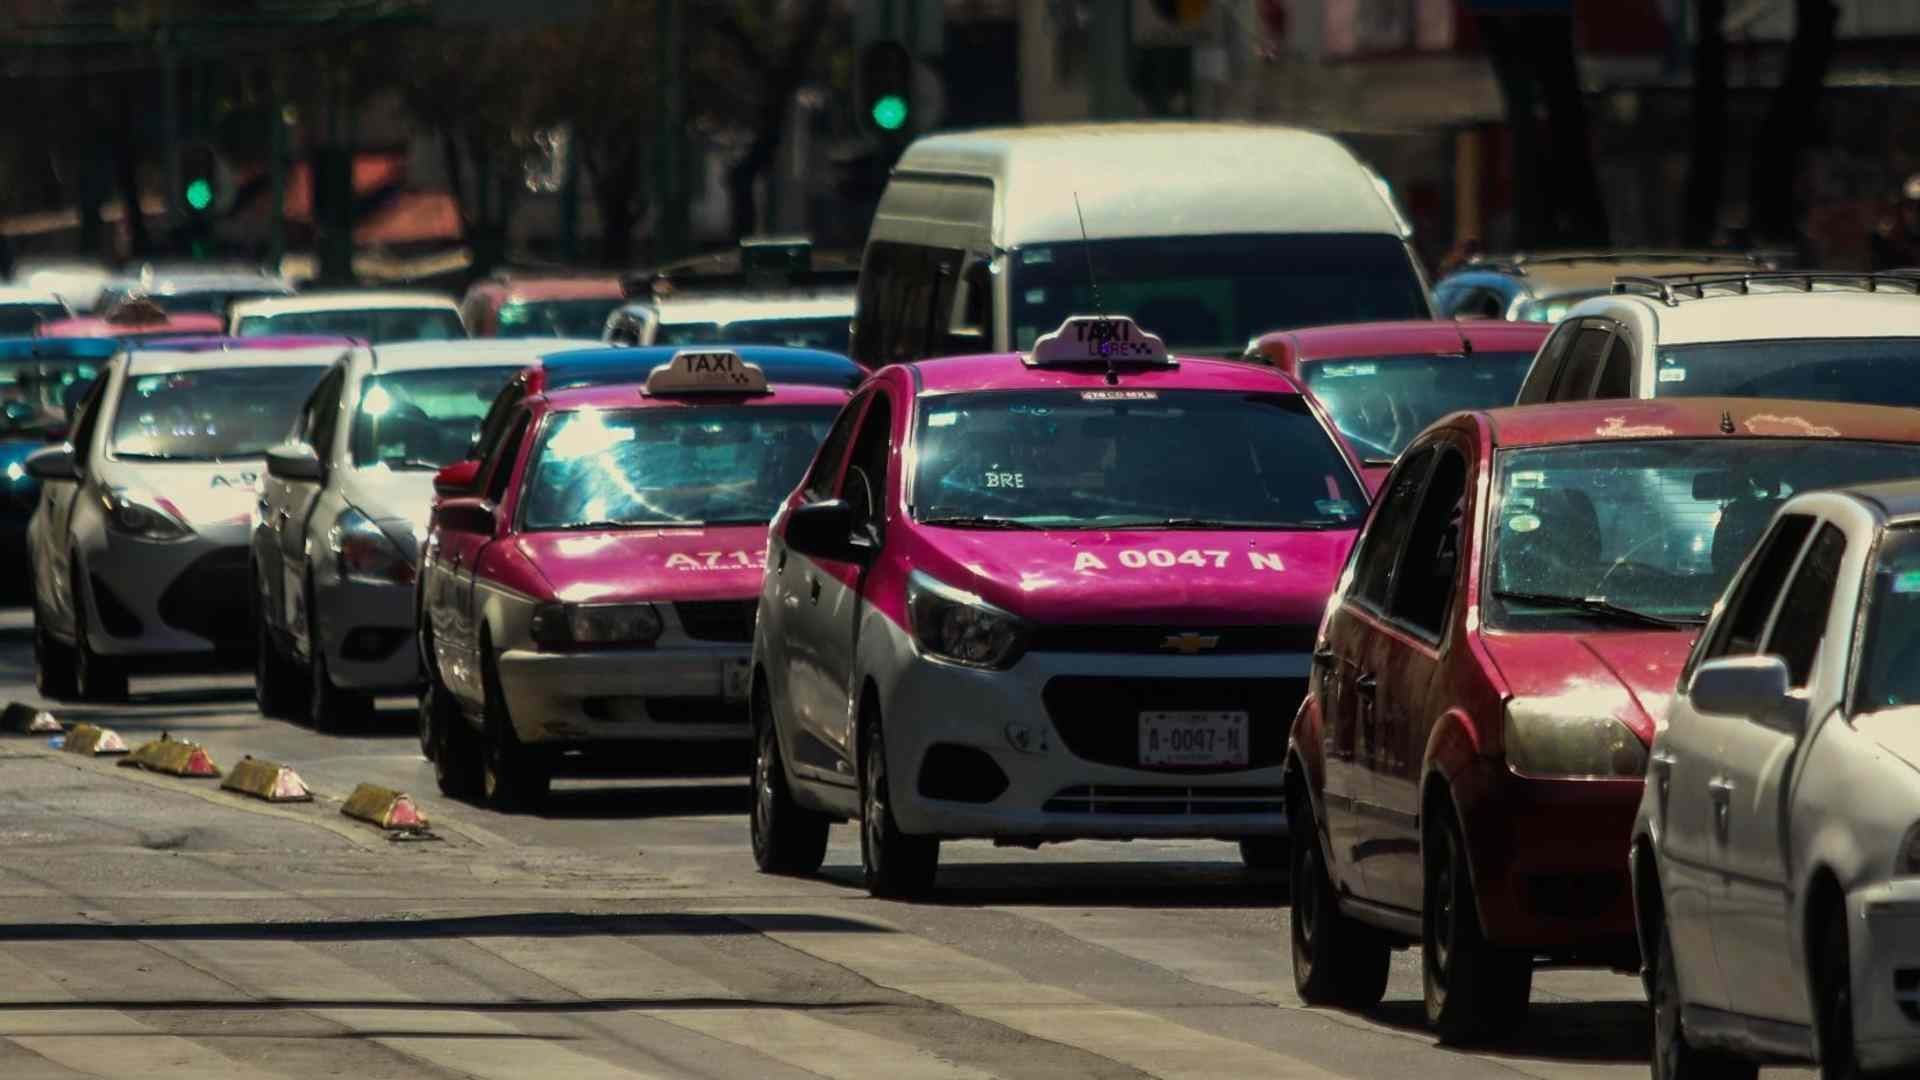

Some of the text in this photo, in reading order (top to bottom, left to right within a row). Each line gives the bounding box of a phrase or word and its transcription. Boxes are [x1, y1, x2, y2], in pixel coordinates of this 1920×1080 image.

[1073, 320, 1130, 342] TAXI
[682, 353, 734, 373] TAXI
[1073, 549, 1285, 572] A 0047 N
